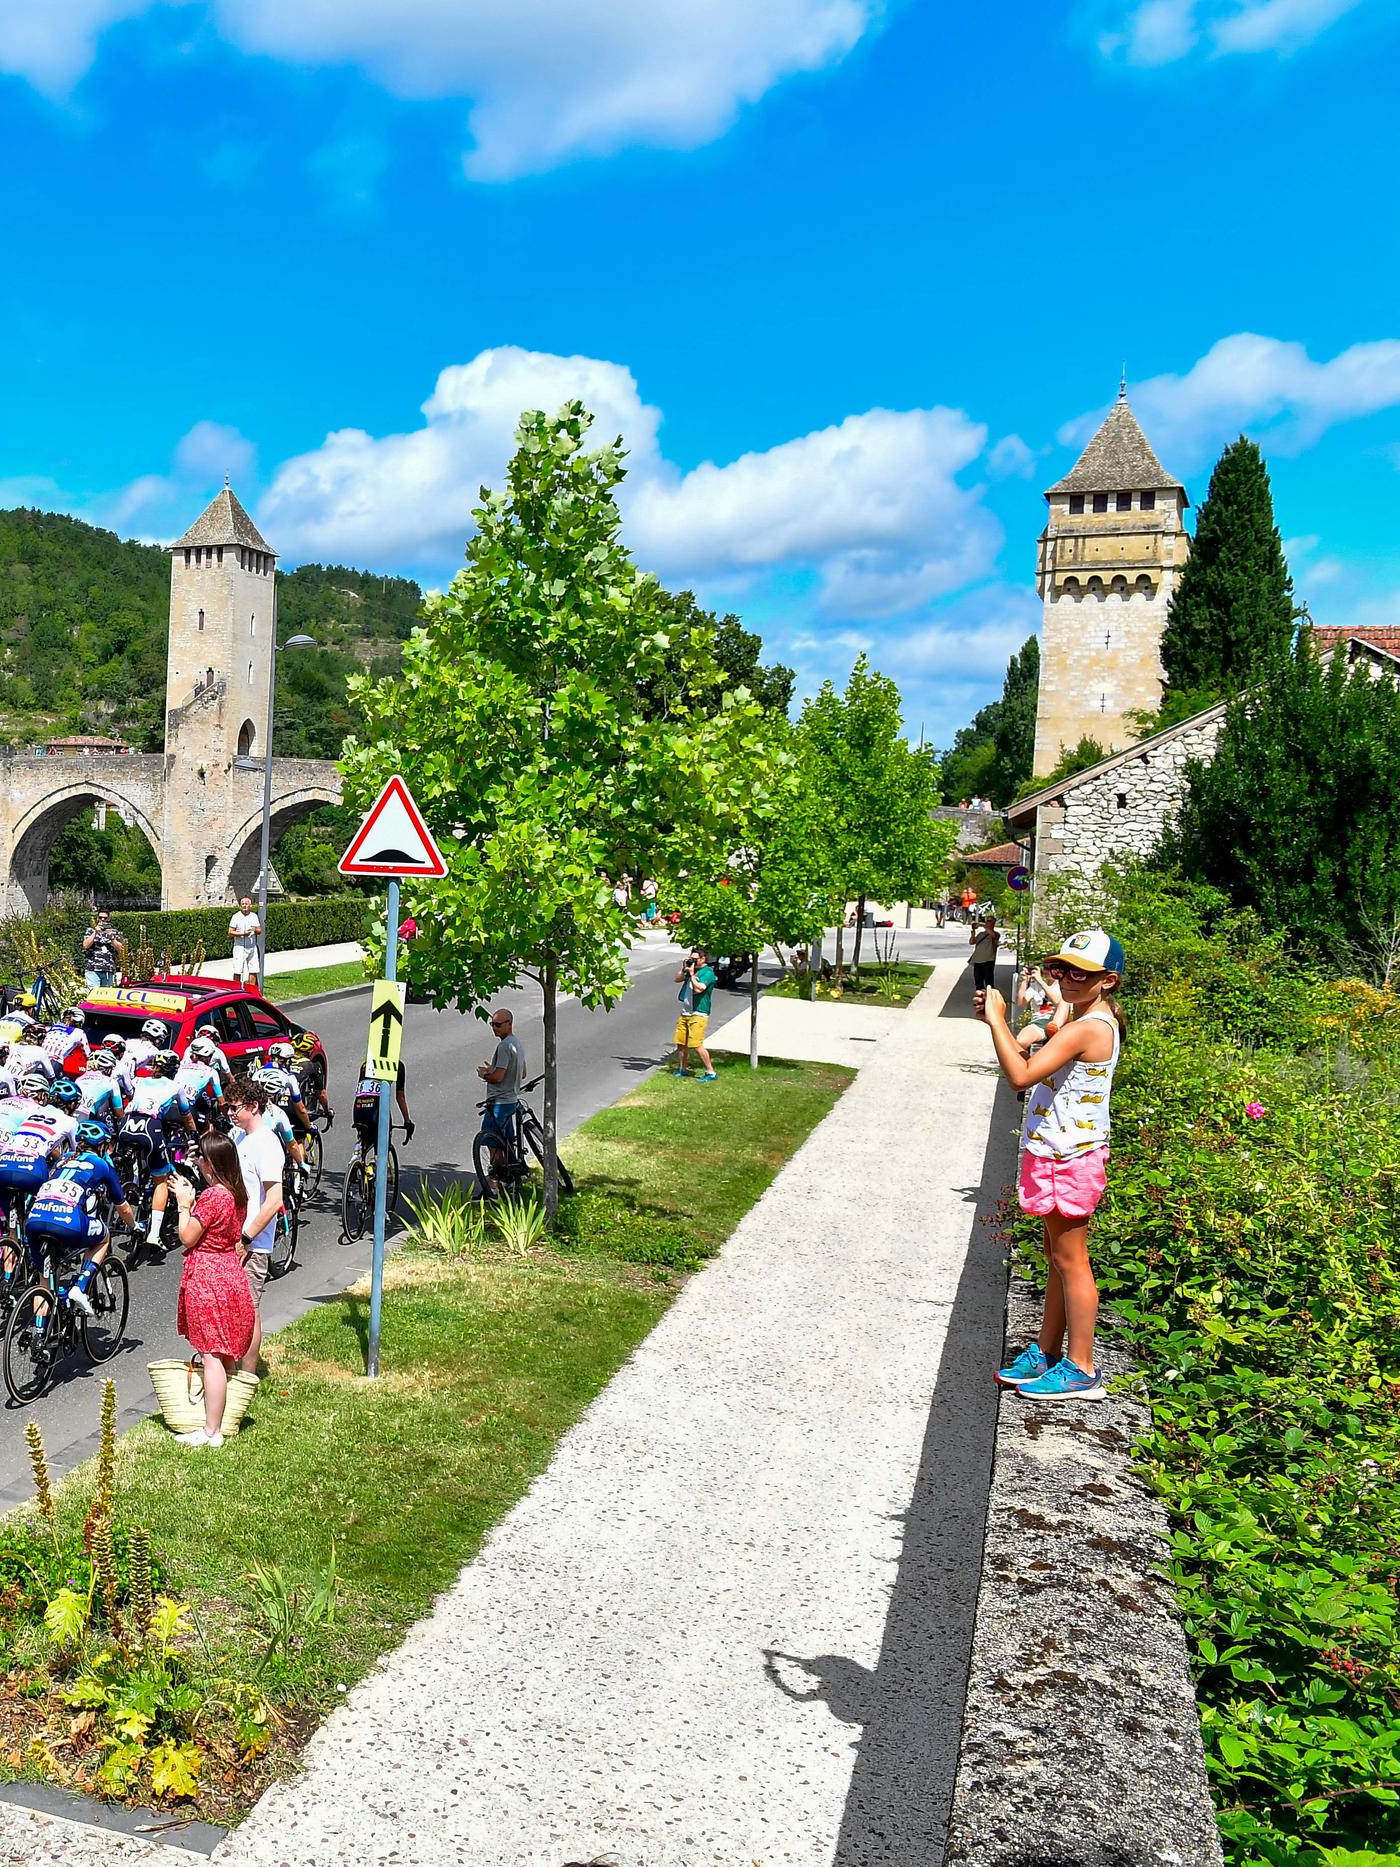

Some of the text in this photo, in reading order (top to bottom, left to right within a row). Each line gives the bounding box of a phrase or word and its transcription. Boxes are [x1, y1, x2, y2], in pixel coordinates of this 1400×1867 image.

[116, 989, 151, 1004] LCL
[368, 1081, 381, 1093] 36
[22, 1137, 40, 1149] 53
[60, 1181, 77, 1197] 55
